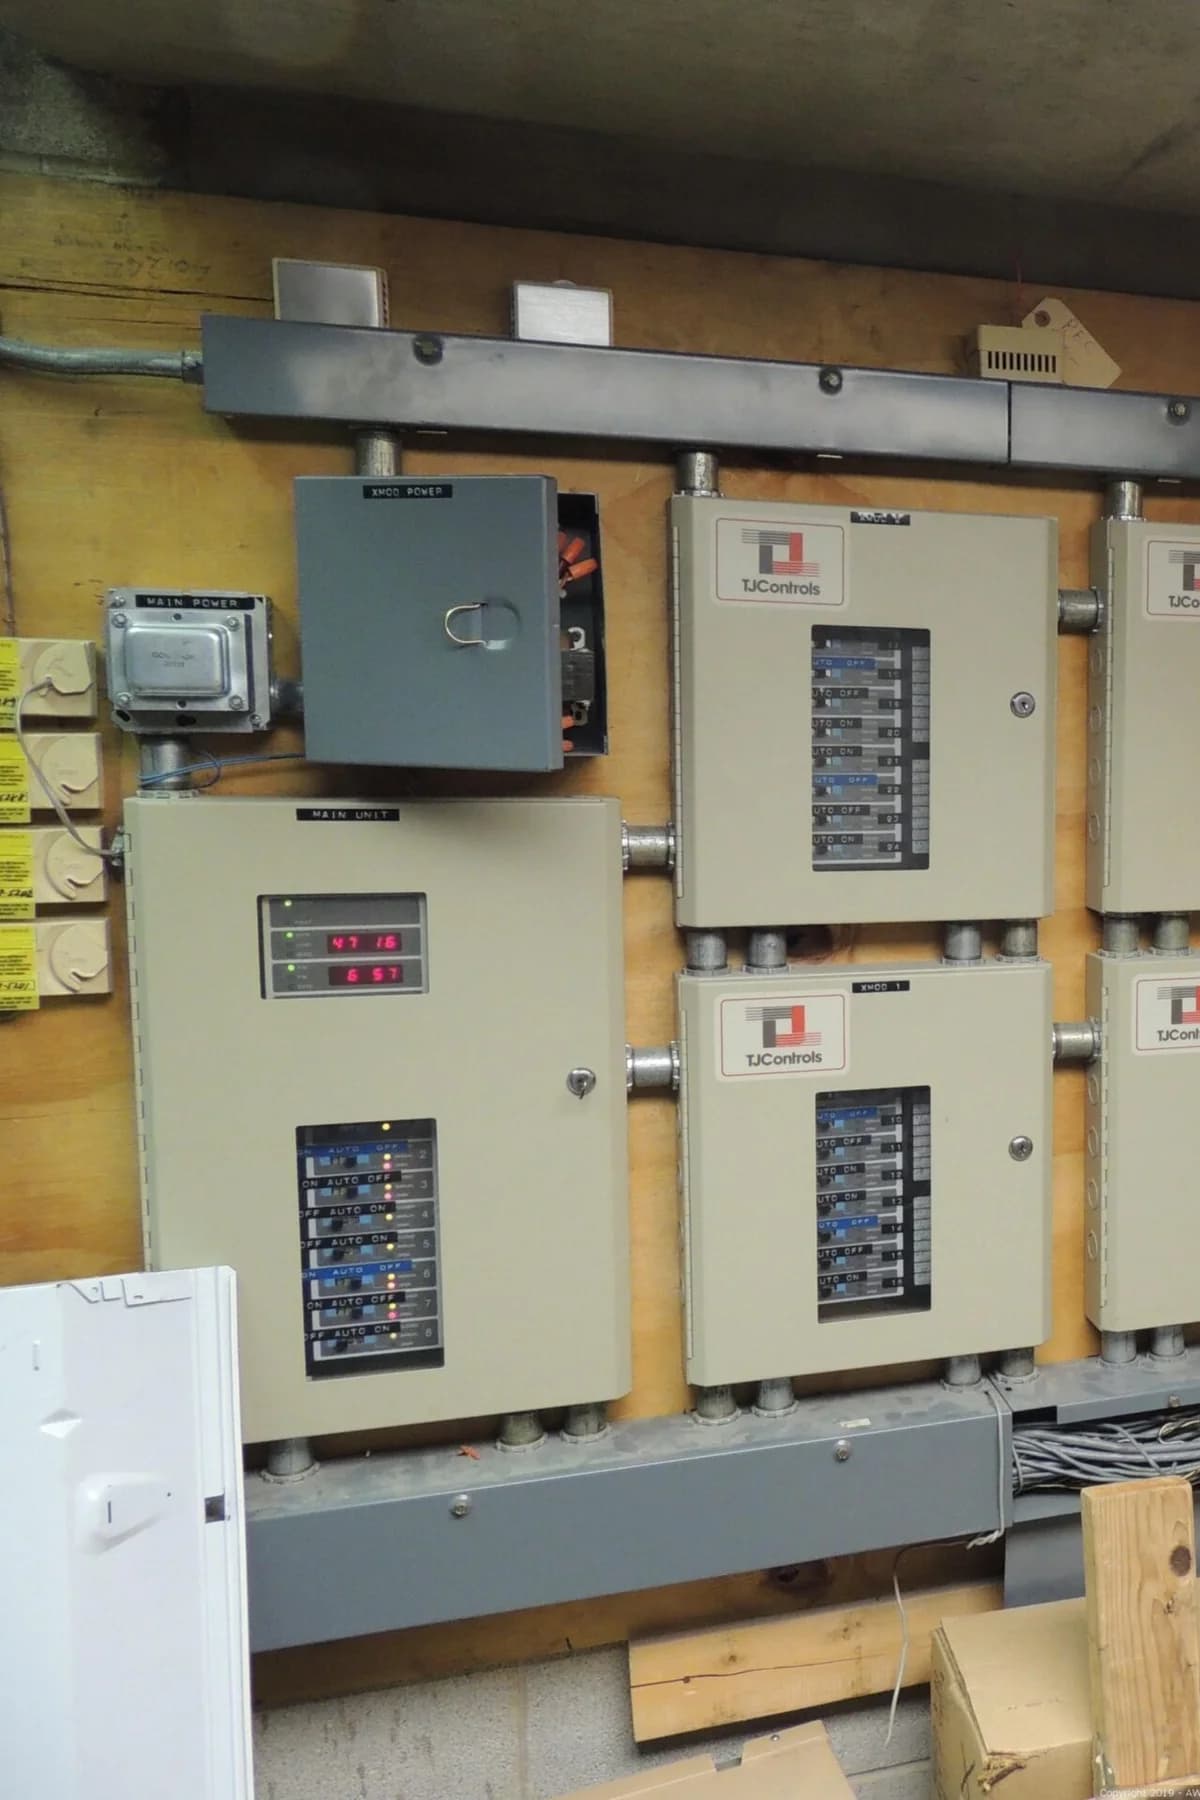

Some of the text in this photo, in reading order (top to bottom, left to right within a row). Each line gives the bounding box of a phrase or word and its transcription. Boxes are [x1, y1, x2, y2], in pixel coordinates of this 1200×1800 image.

[407, 487, 442, 496] POWER
[741, 578, 820, 596] TJControls
[146, 597, 239, 608] MAIN POWER
[313, 810, 388, 819] MAIN UNIT
[332, 936, 360, 949] 47
[347, 967, 399, 982] 6 57
[745, 1051, 823, 1067] TJControls
[328, 1145, 360, 1153] AUTO
[376, 1143, 399, 1152] OFF
[816, 1140, 836, 1148] UTO
[302, 1174, 391, 1188] ON AUTO OFF
[817, 1195, 838, 1203] UTO
[329, 1206, 362, 1216] AUTO
[369, 1204, 386, 1213] ON
[331, 1237, 363, 1246] AUTO
[371, 1235, 388, 1243] ON
[818, 1249, 838, 1258] UTO
[333, 1267, 363, 1275] AUTO
[380, 1263, 401, 1271] OFF
[819, 1275, 840, 1285] UTO
[307, 1295, 395, 1310] ON AUTO OFF
[334, 1327, 366, 1337] AUTO
[374, 1325, 390, 1333] ON
